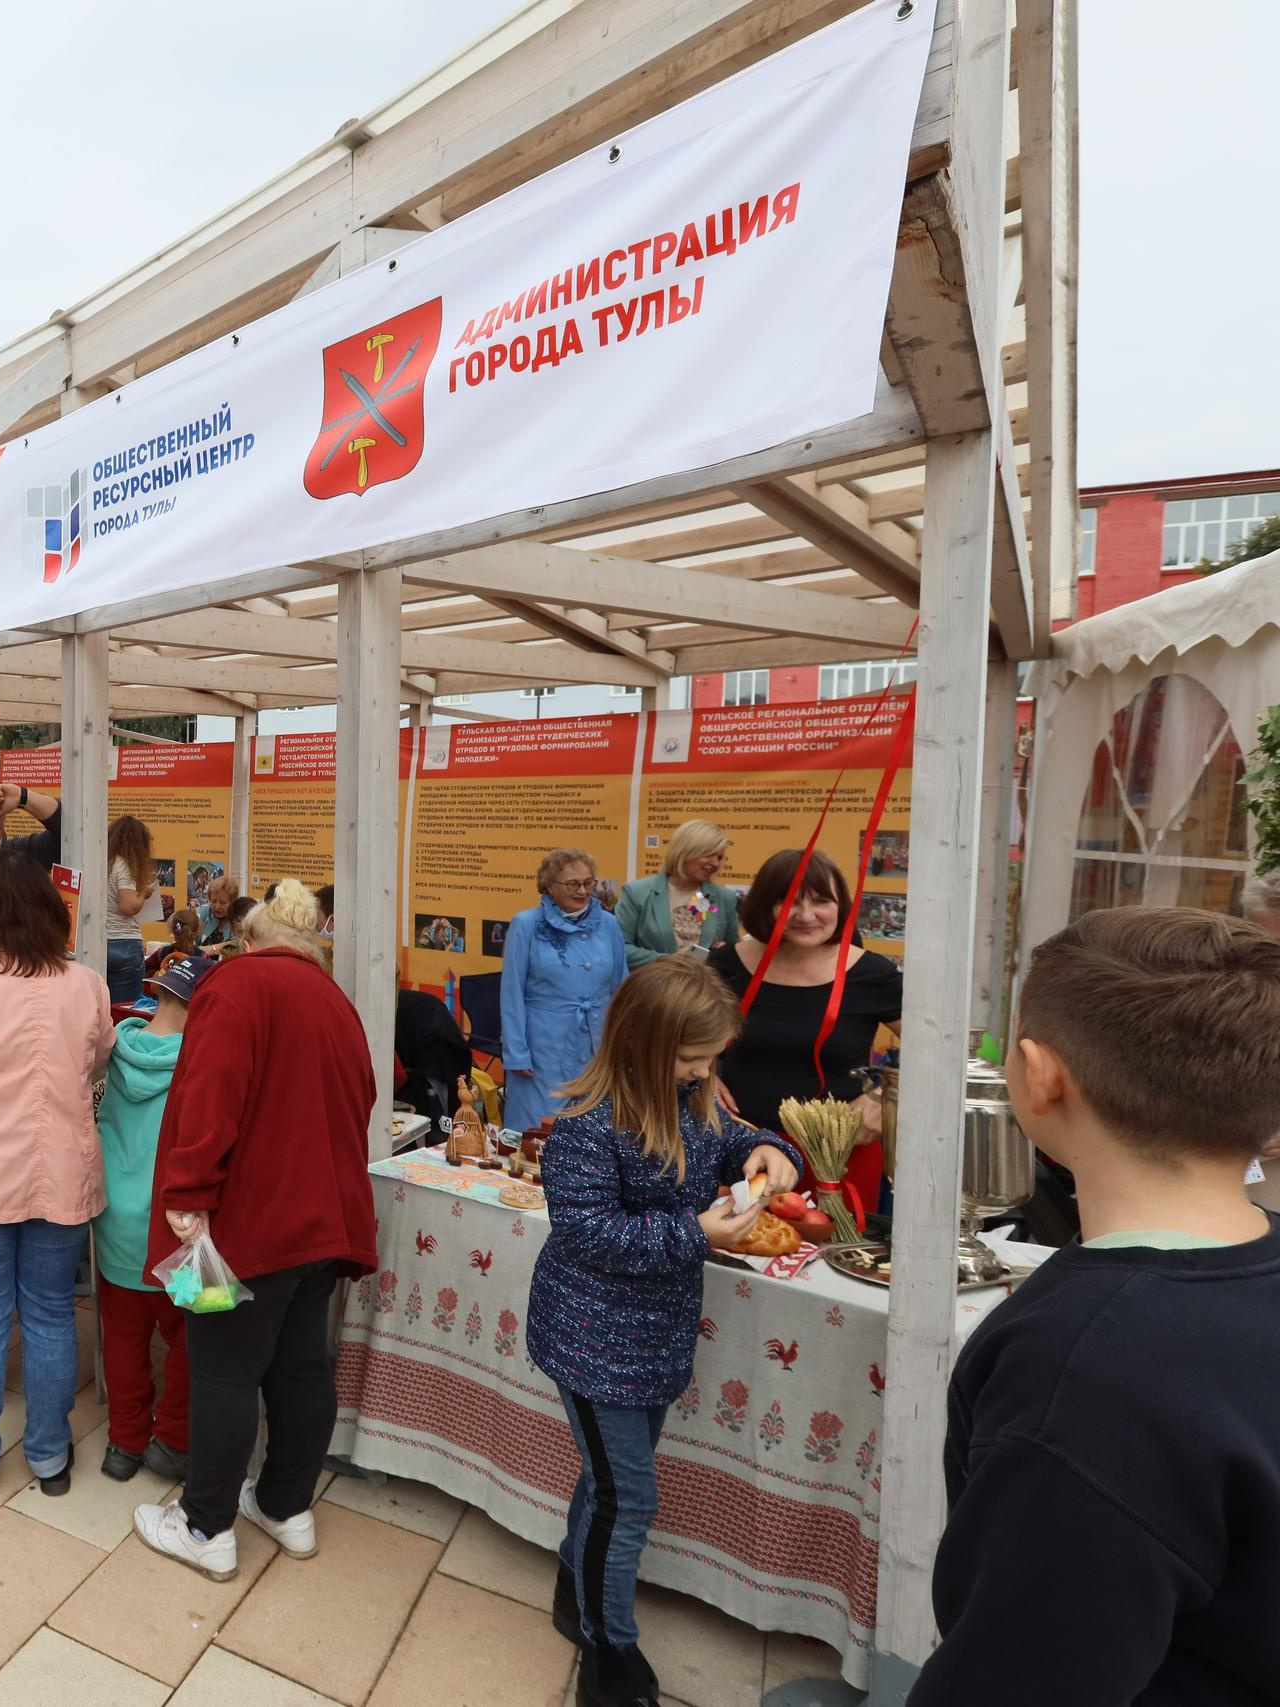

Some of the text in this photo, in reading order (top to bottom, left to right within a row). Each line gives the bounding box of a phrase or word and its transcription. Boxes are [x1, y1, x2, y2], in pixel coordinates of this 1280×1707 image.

[453, 182, 801, 349] АДМИНИСТРАЦИЯ
[449, 276, 705, 393] ГОРОДА ТУЛЫ
[93, 402, 232, 482] ОБЩЕСТВЕННЫЙ
[93, 433, 255, 510] РЕСУРСНЫЙ ЦЕНТР
[93, 496, 177, 538] ГОРОДА ТУЛЫ
[701, 711, 755, 722] ТУЛЬСКОЕ
[757, 705, 846, 719] РЕГИОНАЛЬНОЕ
[457, 720, 613, 735] ТУЛЬСКАЯ ОБЛАСТНАЯ ОБЩЕСТВЕННАЯ
[699, 719, 802, 733] ОБЩЕРОССИЙСКОЙ
[456, 731, 602, 744] ОРГАНИЗАЦИЯ «ШТАБ СТУДЕНЧЕСКИХ
[698, 730, 803, 744] ГОСУДАРСТВЕННОЙ
[279, 745, 333, 753] ОБЩЕРОССИЙСКОЙ
[455, 746, 489, 754] ОТРЯДОВ
[496, 744, 539, 752] ТРУДОВЫХ
[540, 740, 609, 750] ФОРМИРОВАНИЙ
[697, 742, 839, 755] "СОЮЗ ЖЕНЩИН РОССИИ"
[279, 753, 334, 761] ГОСУДАРСТВЕННОЙ
